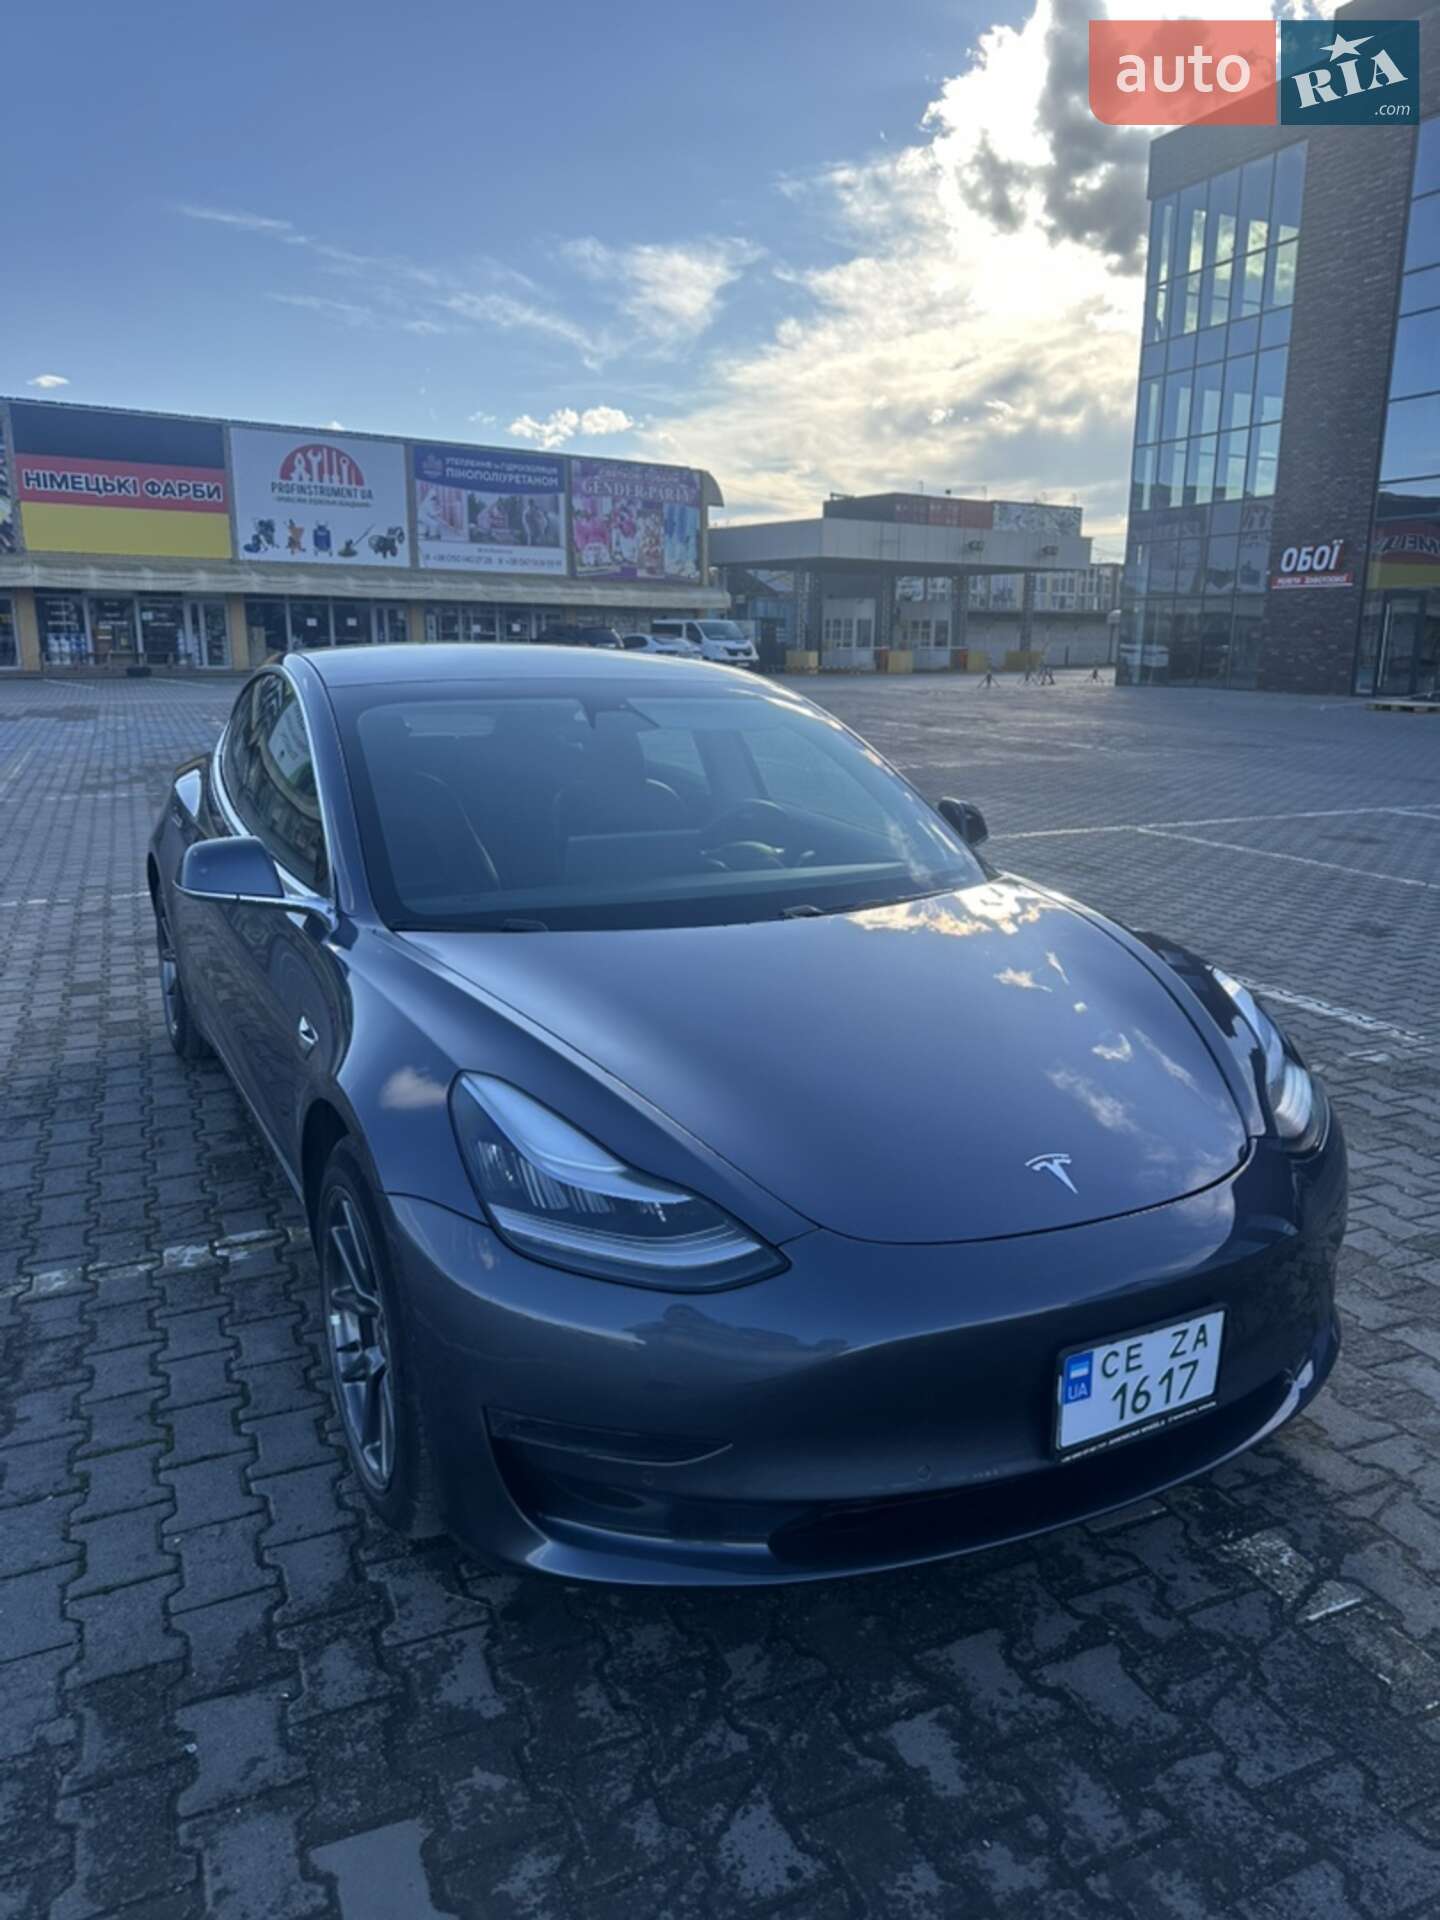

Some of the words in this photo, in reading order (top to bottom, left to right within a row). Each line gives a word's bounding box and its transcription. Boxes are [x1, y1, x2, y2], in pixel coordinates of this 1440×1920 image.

[23, 470, 139, 496] НІМЕЦЬКІ
[144, 479, 222, 501] ФАРБИ
[1280, 539, 1344, 573] ОБОЇ
[1101, 1342, 1143, 1379] CE
[1169, 1323, 1208, 1359] ZA
[1067, 1383, 1088, 1400] UA
[1111, 1359, 1199, 1420] 1617
